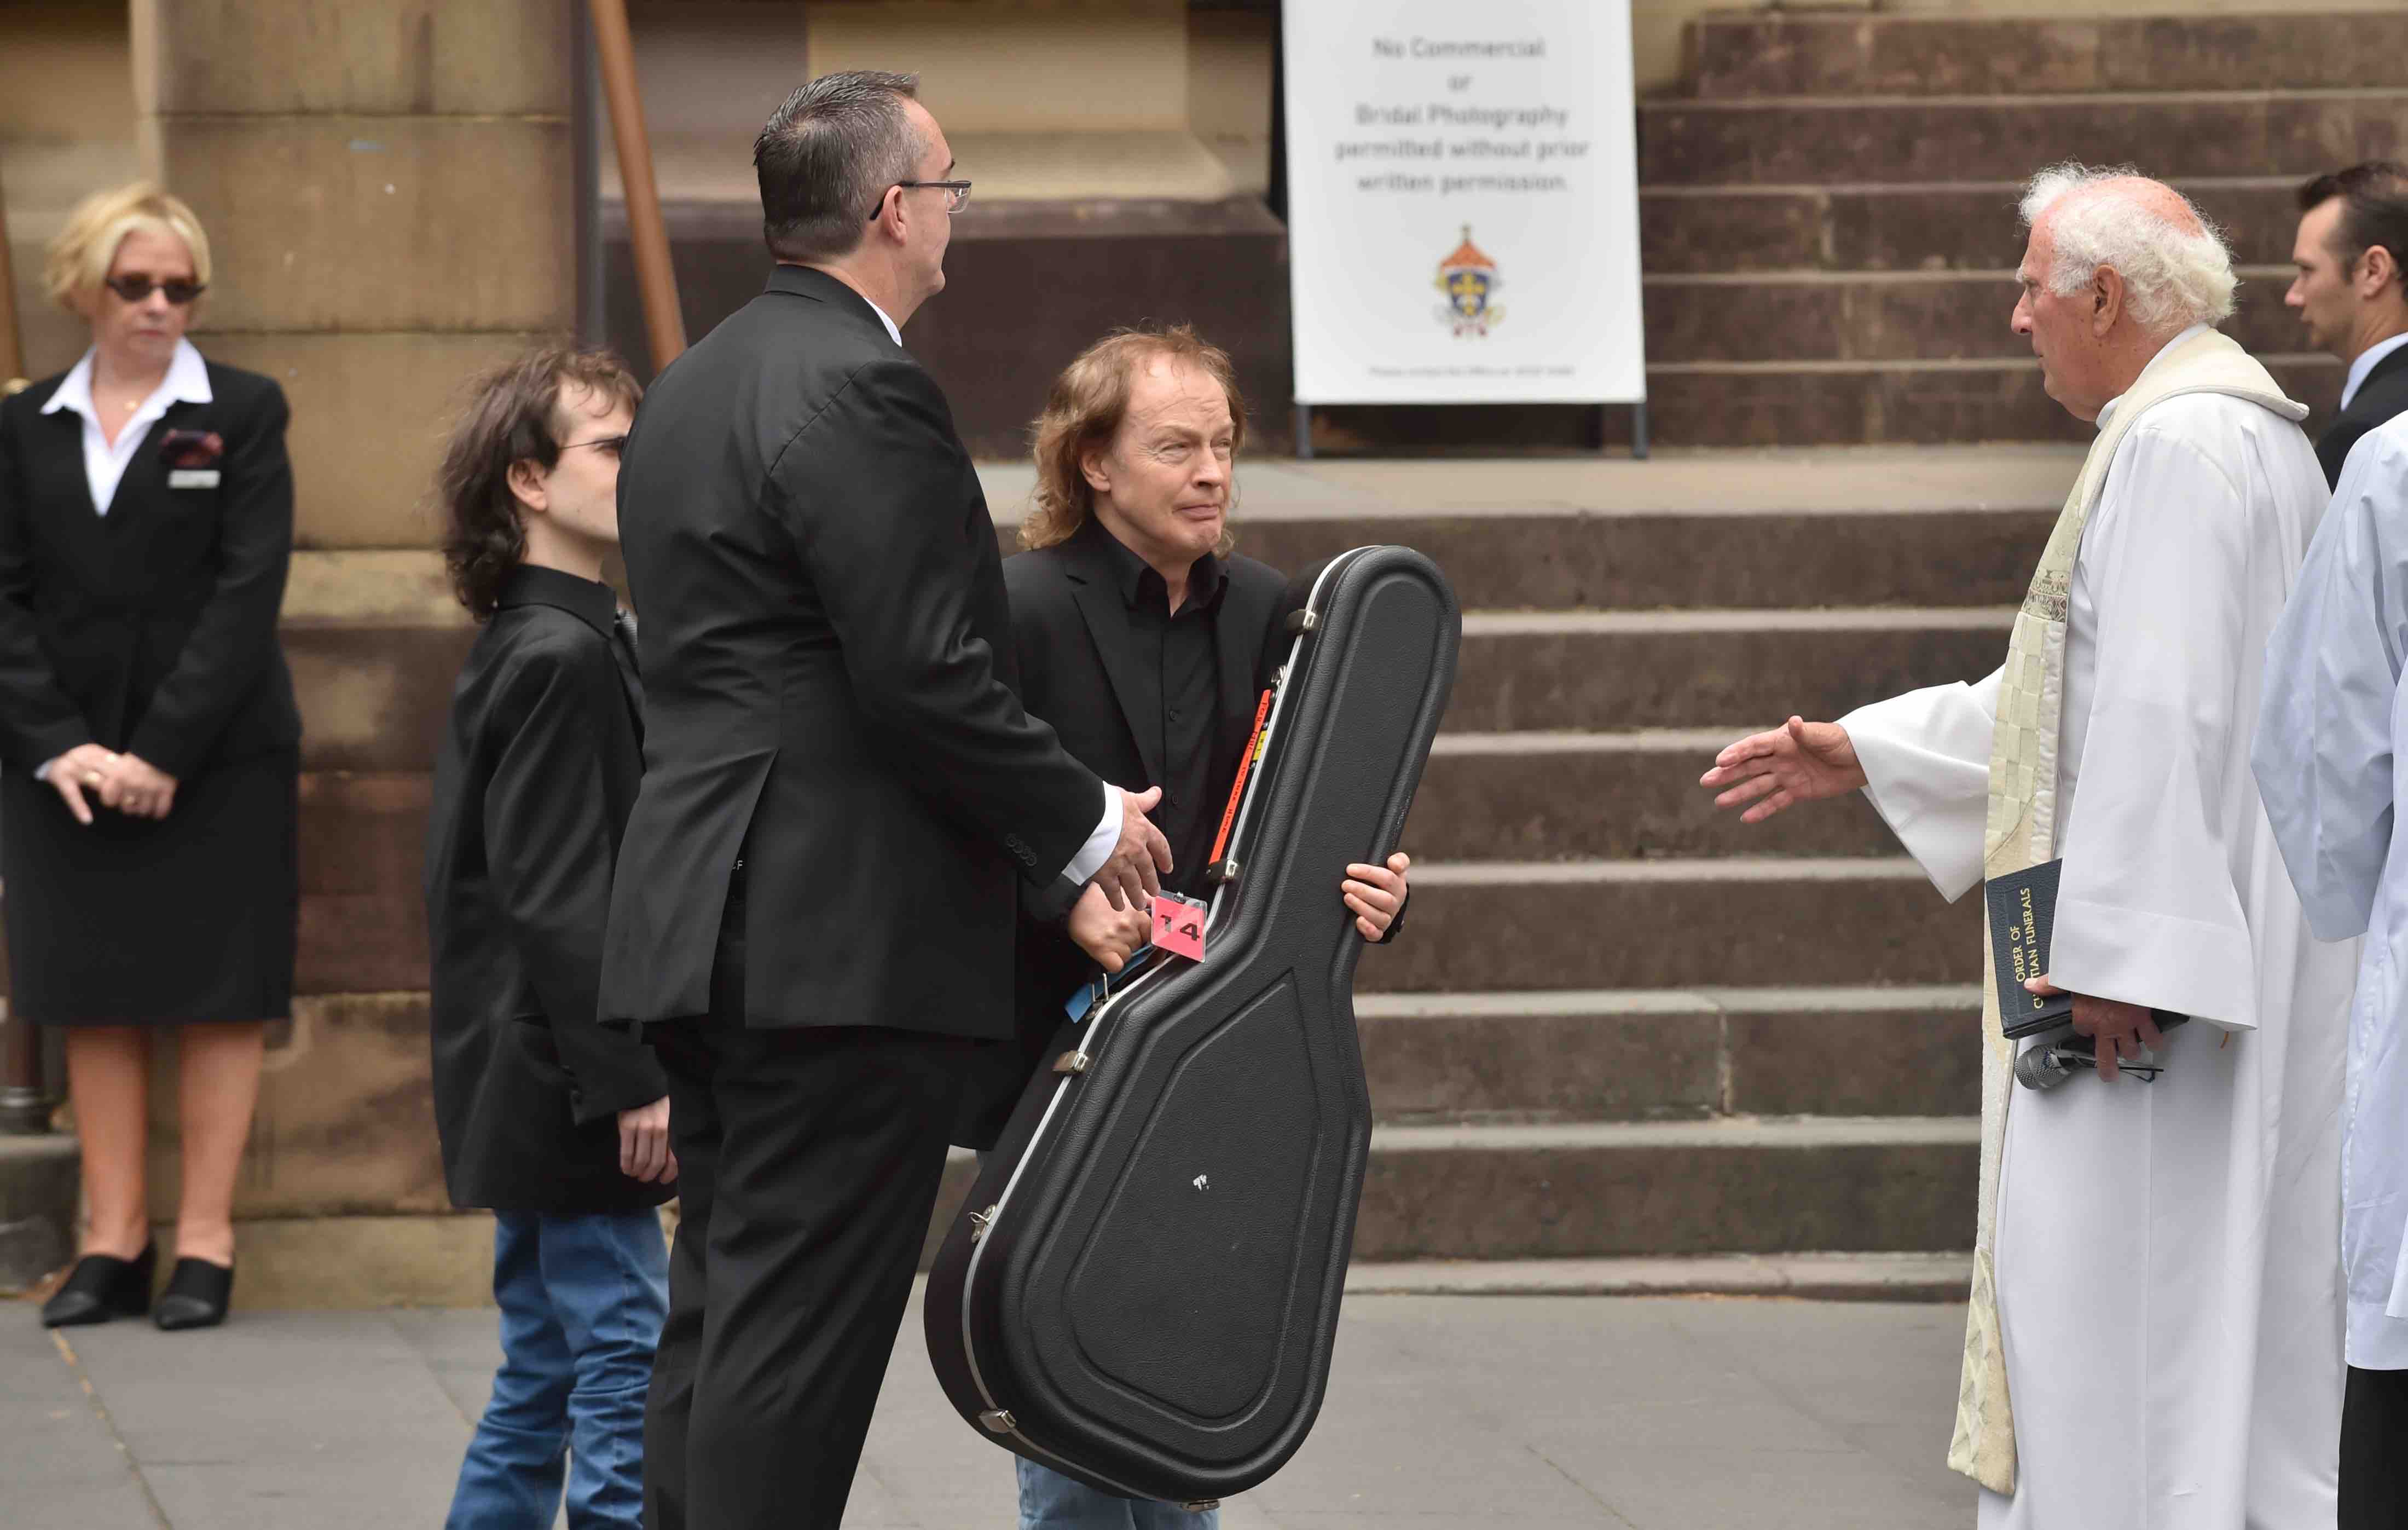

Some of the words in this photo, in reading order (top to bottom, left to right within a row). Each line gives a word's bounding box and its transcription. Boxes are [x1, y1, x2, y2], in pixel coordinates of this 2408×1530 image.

[1373, 38, 1405, 58] No
[1411, 38, 1545, 57] Commercial
[1448, 74, 1471, 91] or
[1356, 104, 1421, 126] Bridal
[1427, 104, 1568, 130] Photography
[1335, 139, 1443, 162] permitted
[1450, 139, 1531, 159] without
[1537, 140, 1589, 161] prior
[1357, 174, 1434, 192] written
[2020, 888, 2036, 945] FUNERALS
[2010, 926, 2021, 941] OF
[2013, 944, 2025, 983] ORDER
[2027, 948, 2044, 1009] CHTIAN
